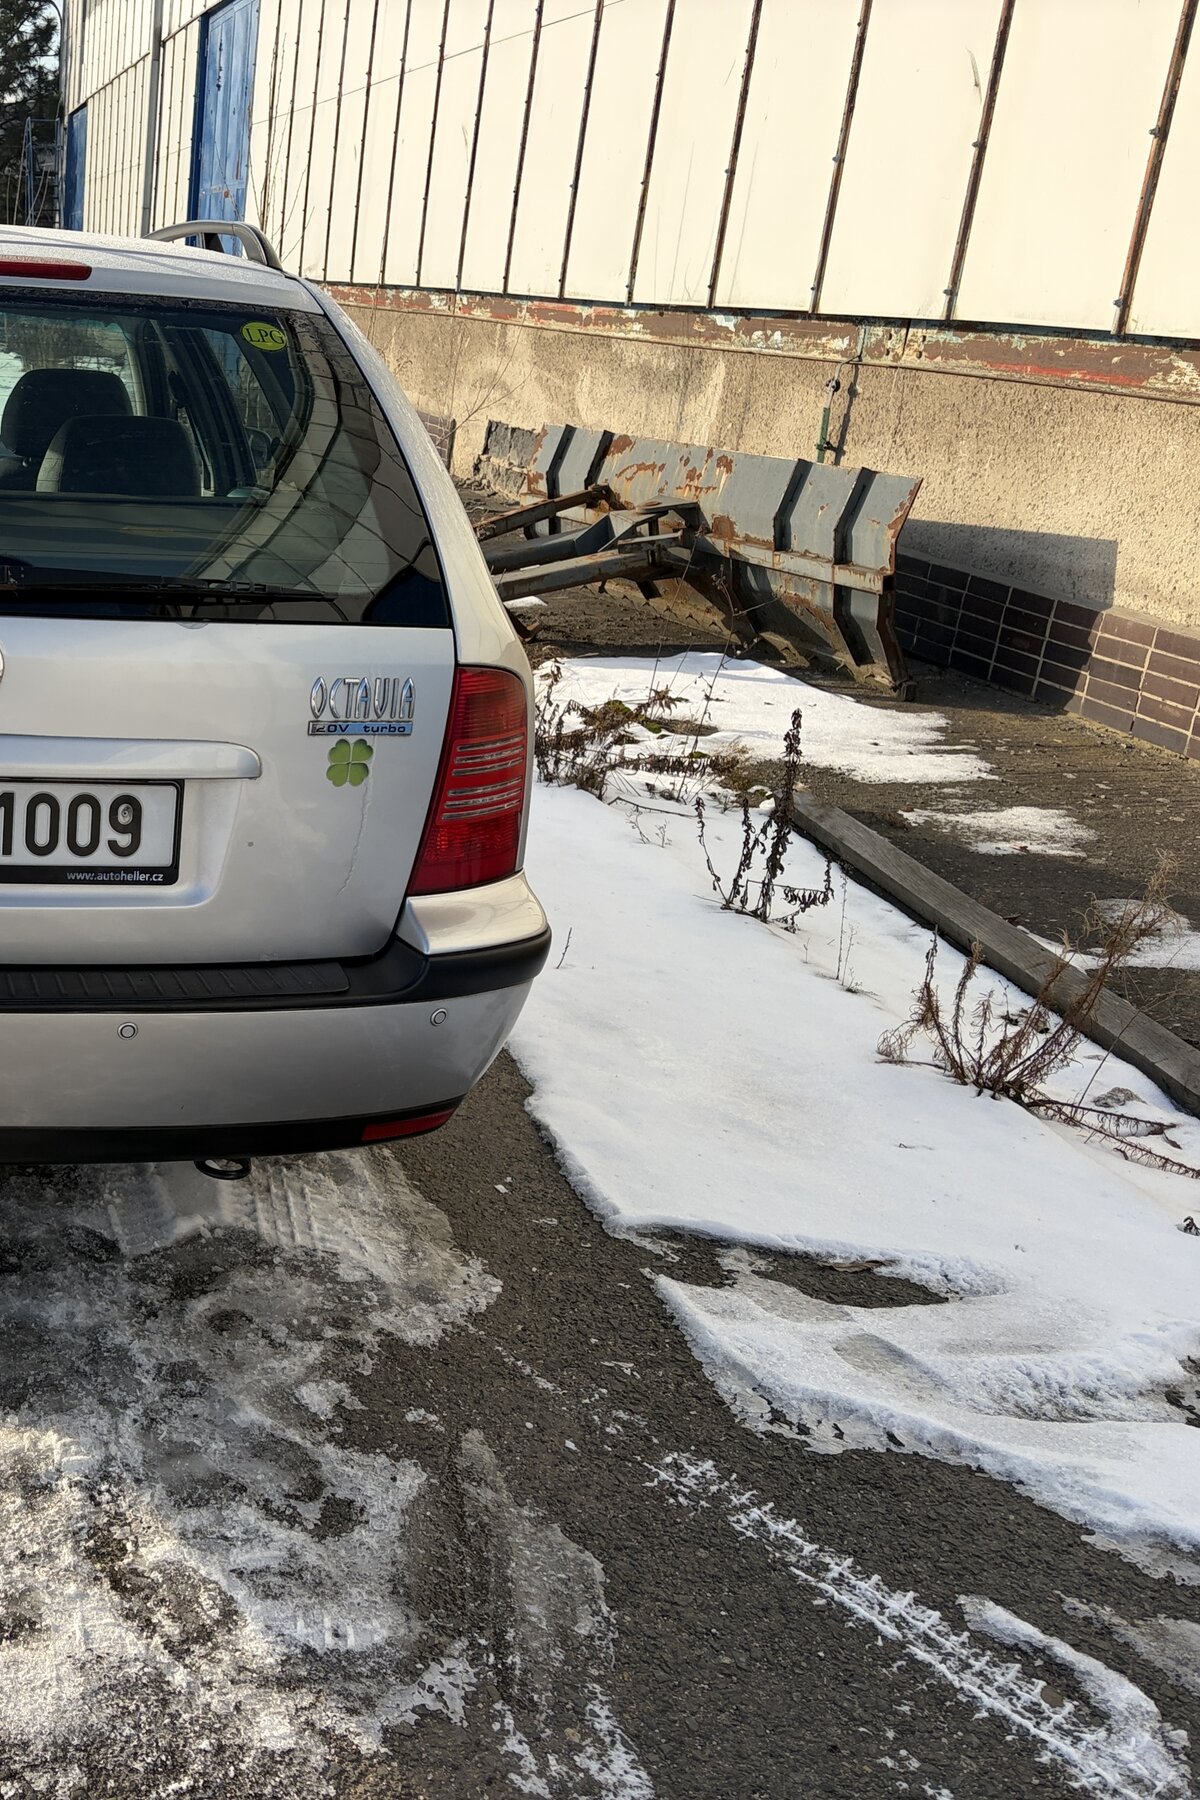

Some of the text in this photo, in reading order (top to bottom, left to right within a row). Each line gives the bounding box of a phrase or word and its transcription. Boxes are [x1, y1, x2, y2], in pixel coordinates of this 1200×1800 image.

[245, 327, 285, 345] LPG
[309, 676, 417, 719] OCTAVIA
[363, 723, 406, 734] turbo
[66, 870, 164, 882] www.autoheller.cz
